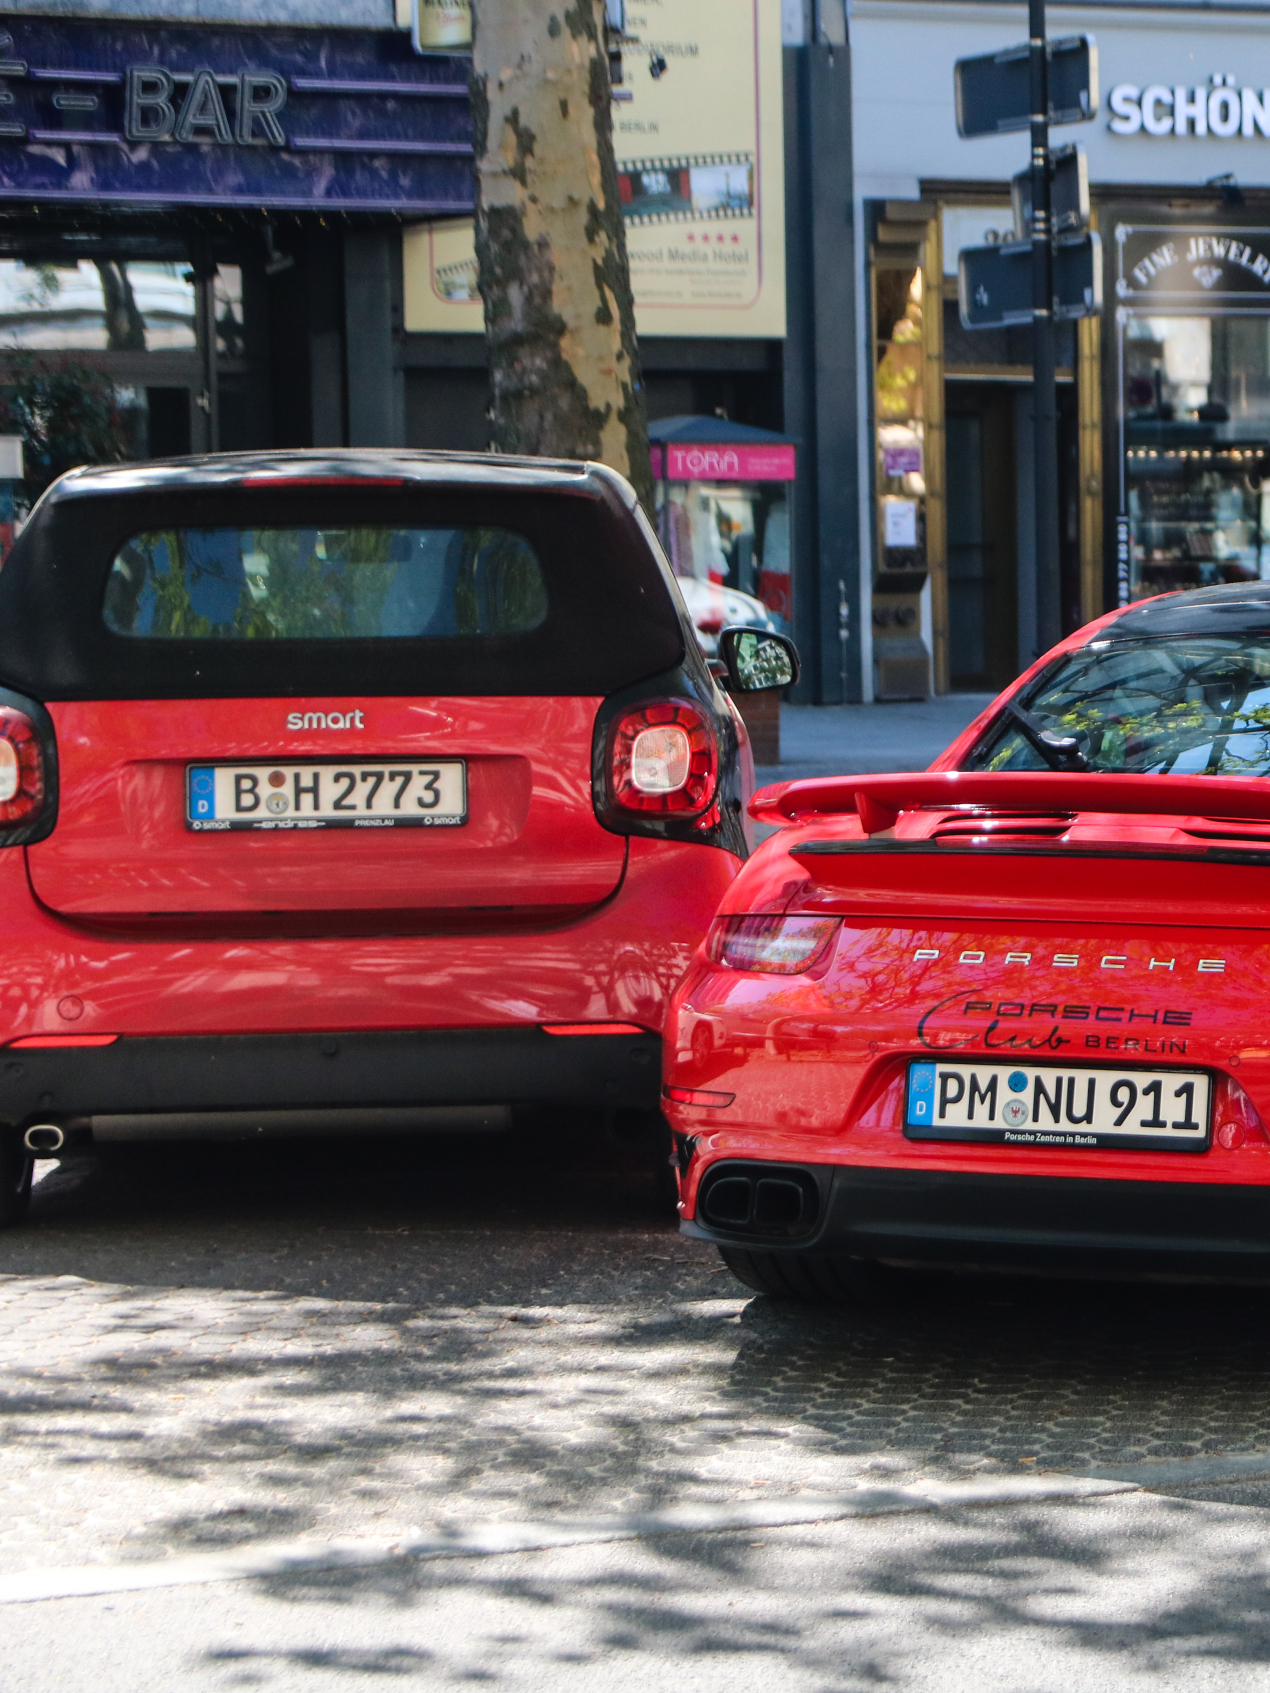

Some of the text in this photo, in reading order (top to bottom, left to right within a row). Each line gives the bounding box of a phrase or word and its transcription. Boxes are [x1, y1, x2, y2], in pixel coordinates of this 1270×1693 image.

[125, 64, 287, 146] BAR
[628, 246, 749, 264] wood Media Hotel
[1133, 242, 1178, 286] FINE
[287, 709, 365, 730] smart
[234, 769, 442, 813] B H 2773
[198, 800, 208, 813] D
[203, 821, 231, 830] smart
[354, 818, 395, 827] PRENZLAU
[434, 816, 461, 825] smart
[913, 949, 1227, 973] PORSCHE
[917, 989, 1187, 1054] Club BERLIN
[963, 1001, 1193, 1026] PORSCHE
[915, 1101, 926, 1115] D
[938, 1071, 1199, 1130] PM NU 911
[1005, 1131, 1097, 1144] Porsche Zentren in Berlin
